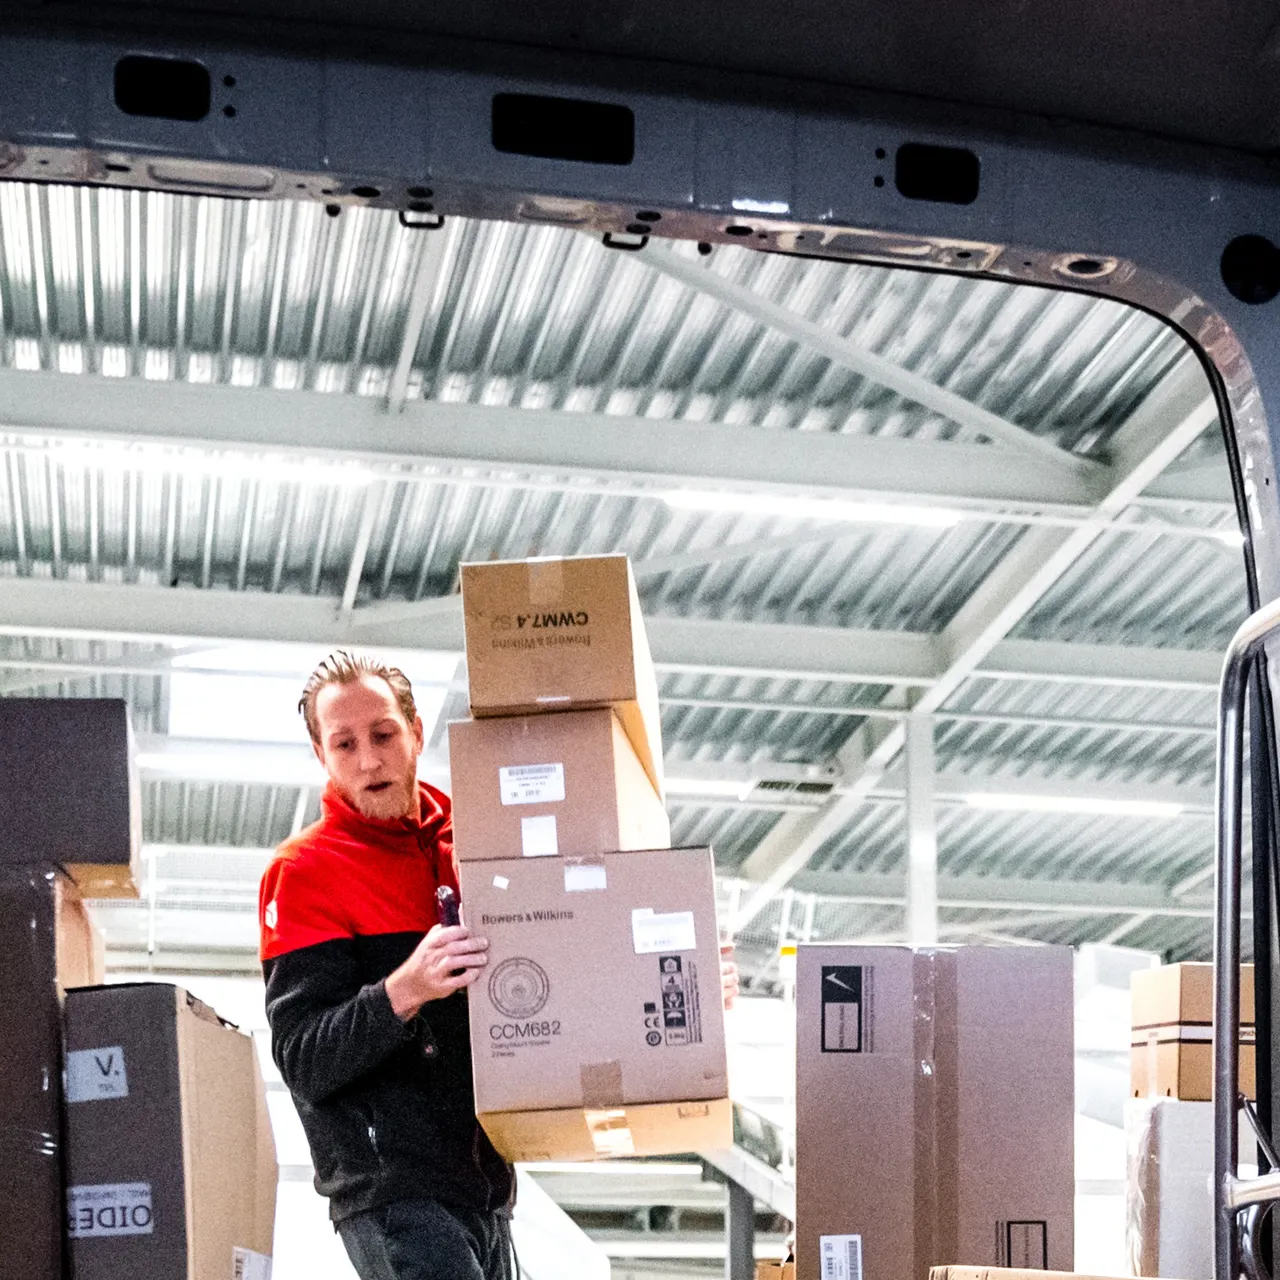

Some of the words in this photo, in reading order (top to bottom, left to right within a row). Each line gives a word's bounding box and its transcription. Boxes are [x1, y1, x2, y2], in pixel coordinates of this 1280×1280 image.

[516, 611, 589, 629] CWM7.4
[481, 913, 524, 925] Bowers
[533, 909, 575, 922] Wilkins
[489, 1020, 561, 1040] CCM682
[94, 1053, 119, 1076] V.
